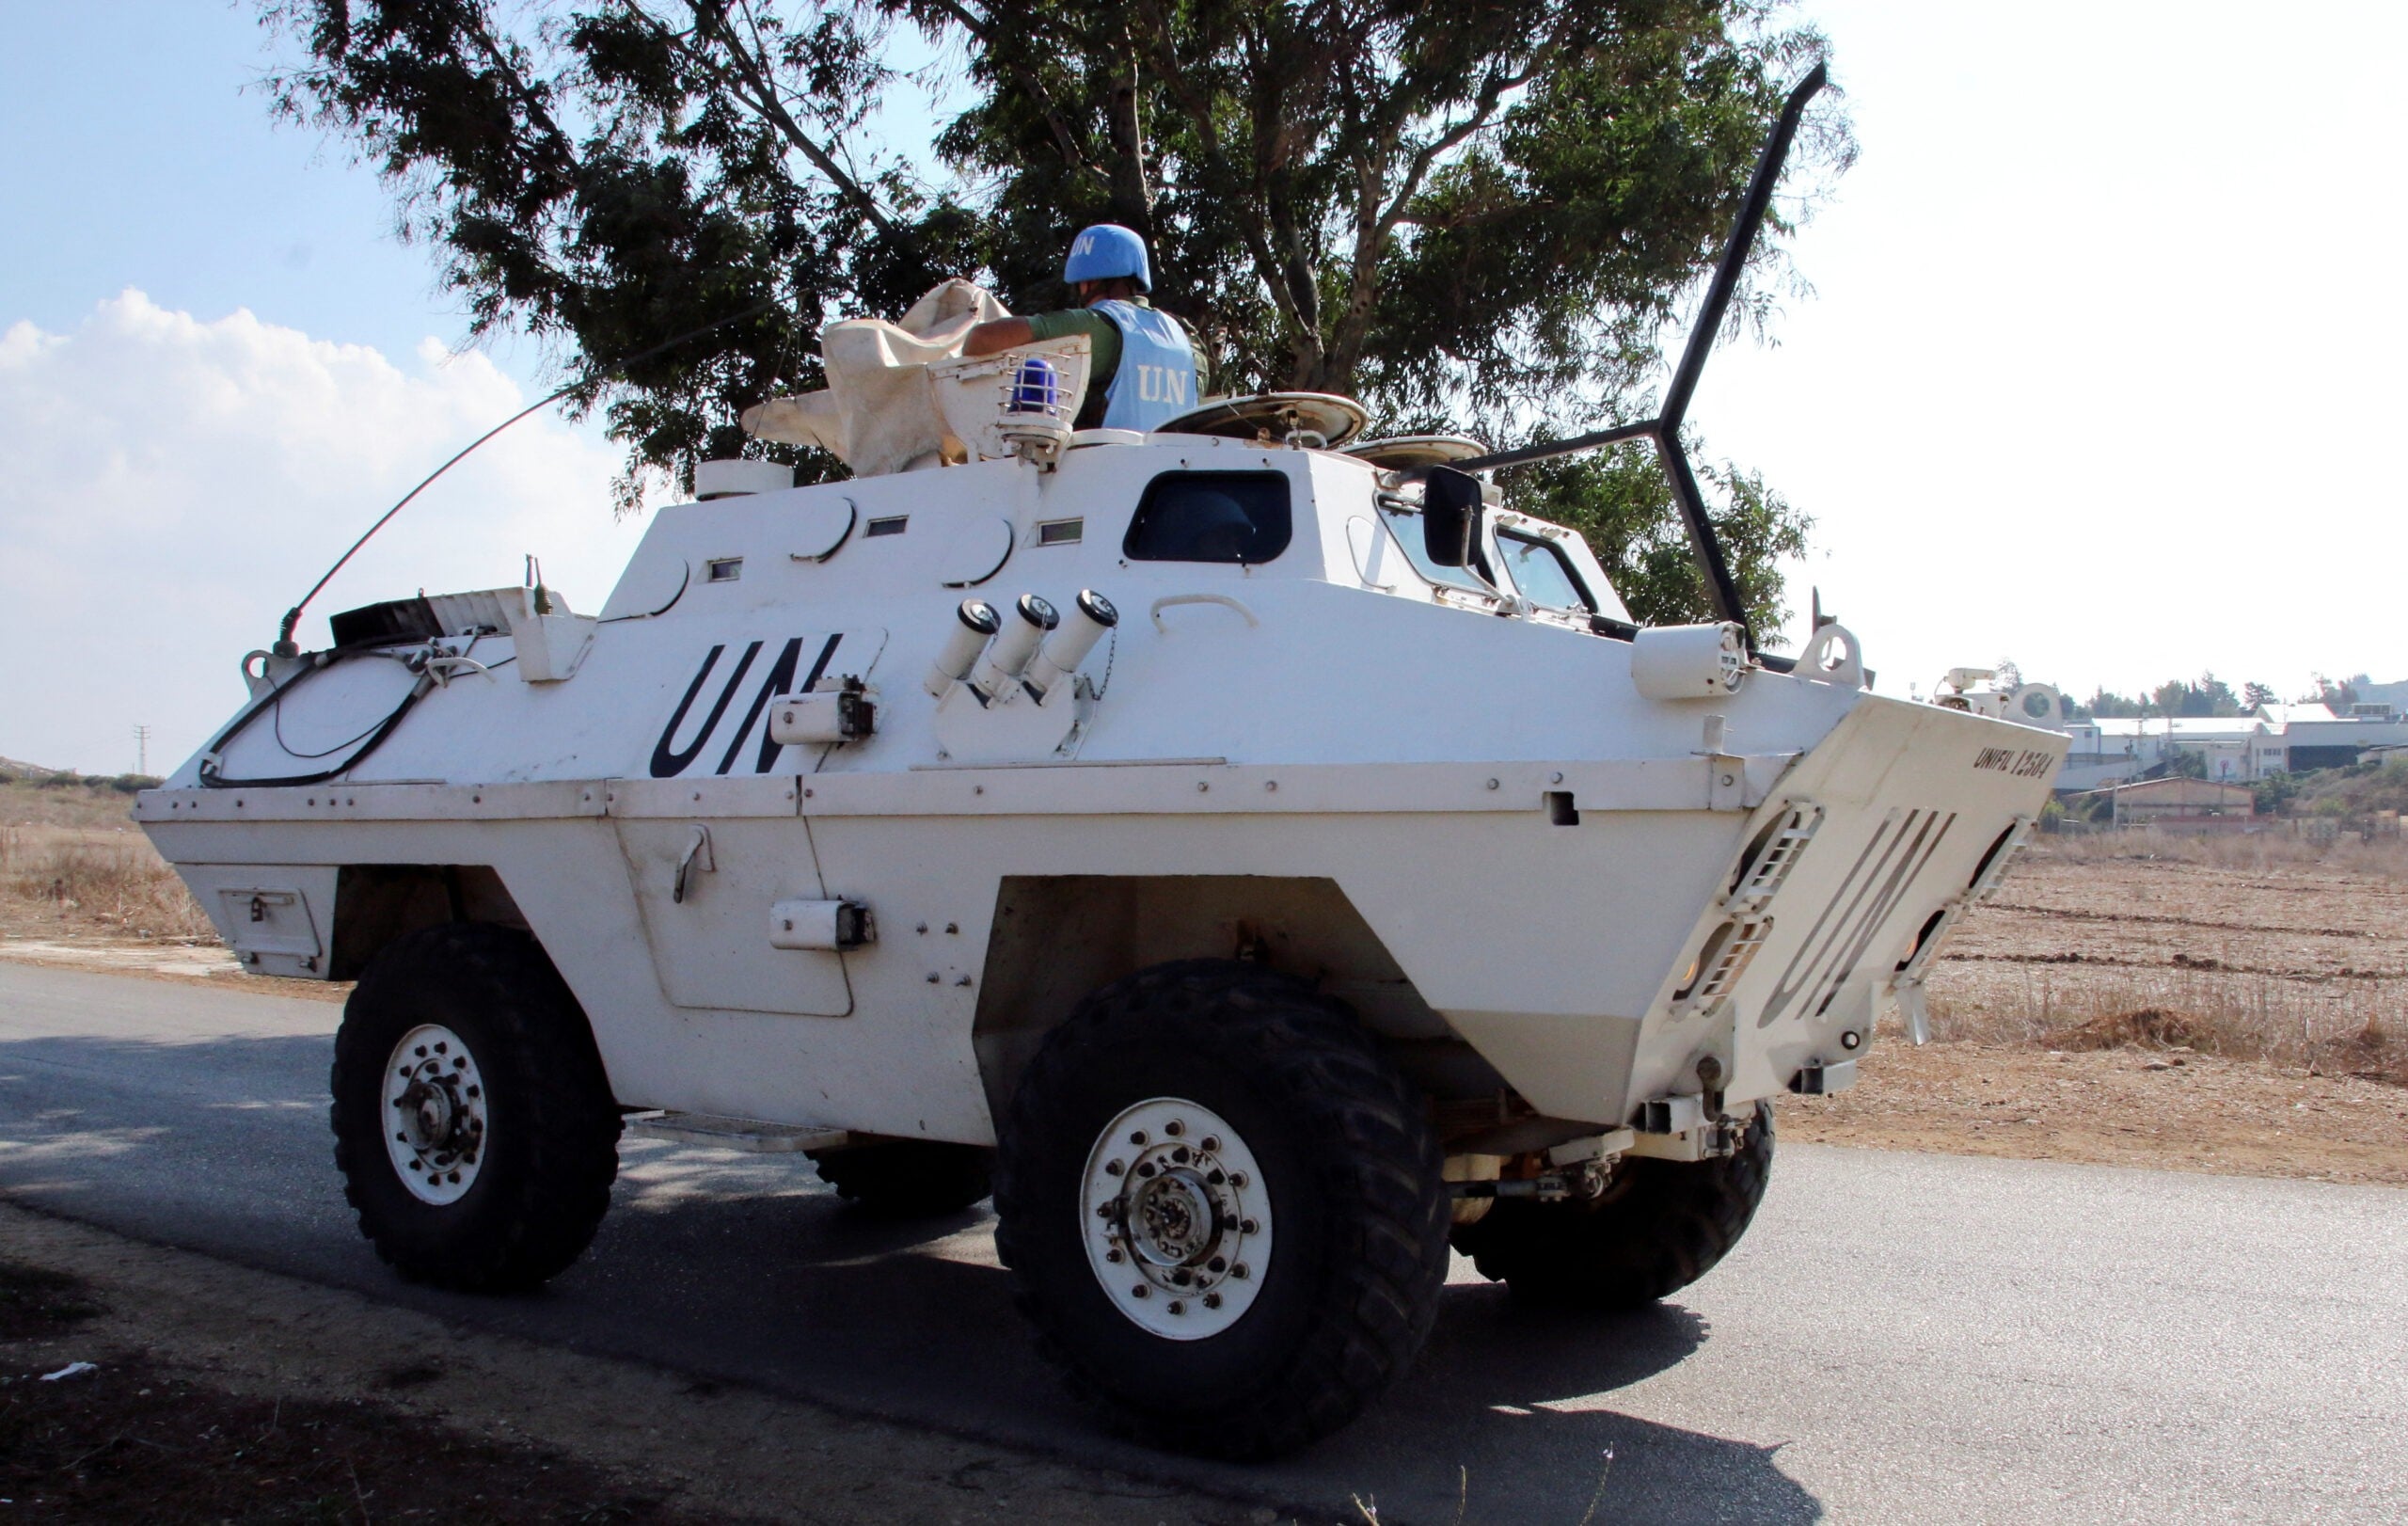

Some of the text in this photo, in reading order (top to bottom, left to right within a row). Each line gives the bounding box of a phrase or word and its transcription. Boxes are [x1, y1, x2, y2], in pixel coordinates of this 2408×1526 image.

[1070, 235, 1095, 257] UN
[1137, 364, 1188, 405] UN
[649, 633, 844, 778] UN
[1973, 747, 2015, 771] UNIFIL
[1757, 806, 1957, 1029] UN
